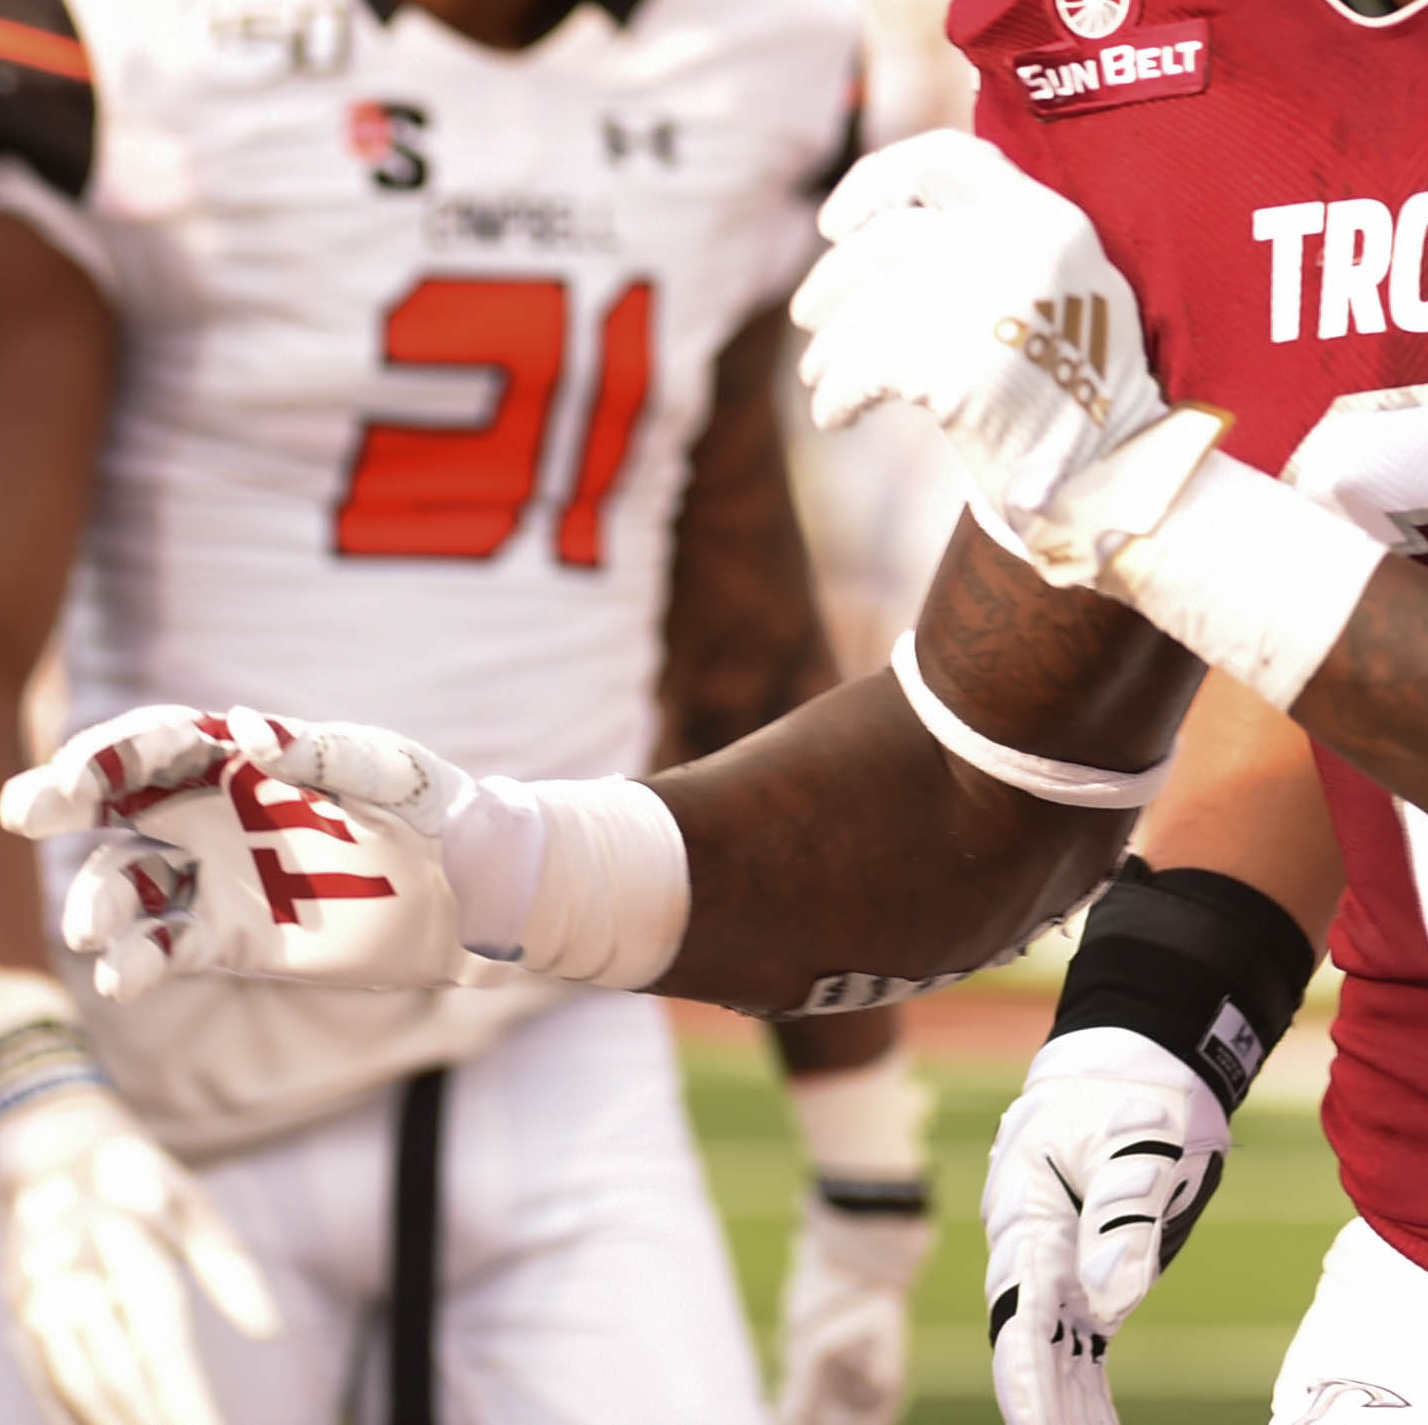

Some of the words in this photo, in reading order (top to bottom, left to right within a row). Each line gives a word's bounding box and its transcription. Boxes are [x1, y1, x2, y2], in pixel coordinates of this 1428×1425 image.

[1015, 59, 1101, 101] SUN
[1099, 40, 1204, 87] BELT
[994, 316, 1114, 431] adidas
